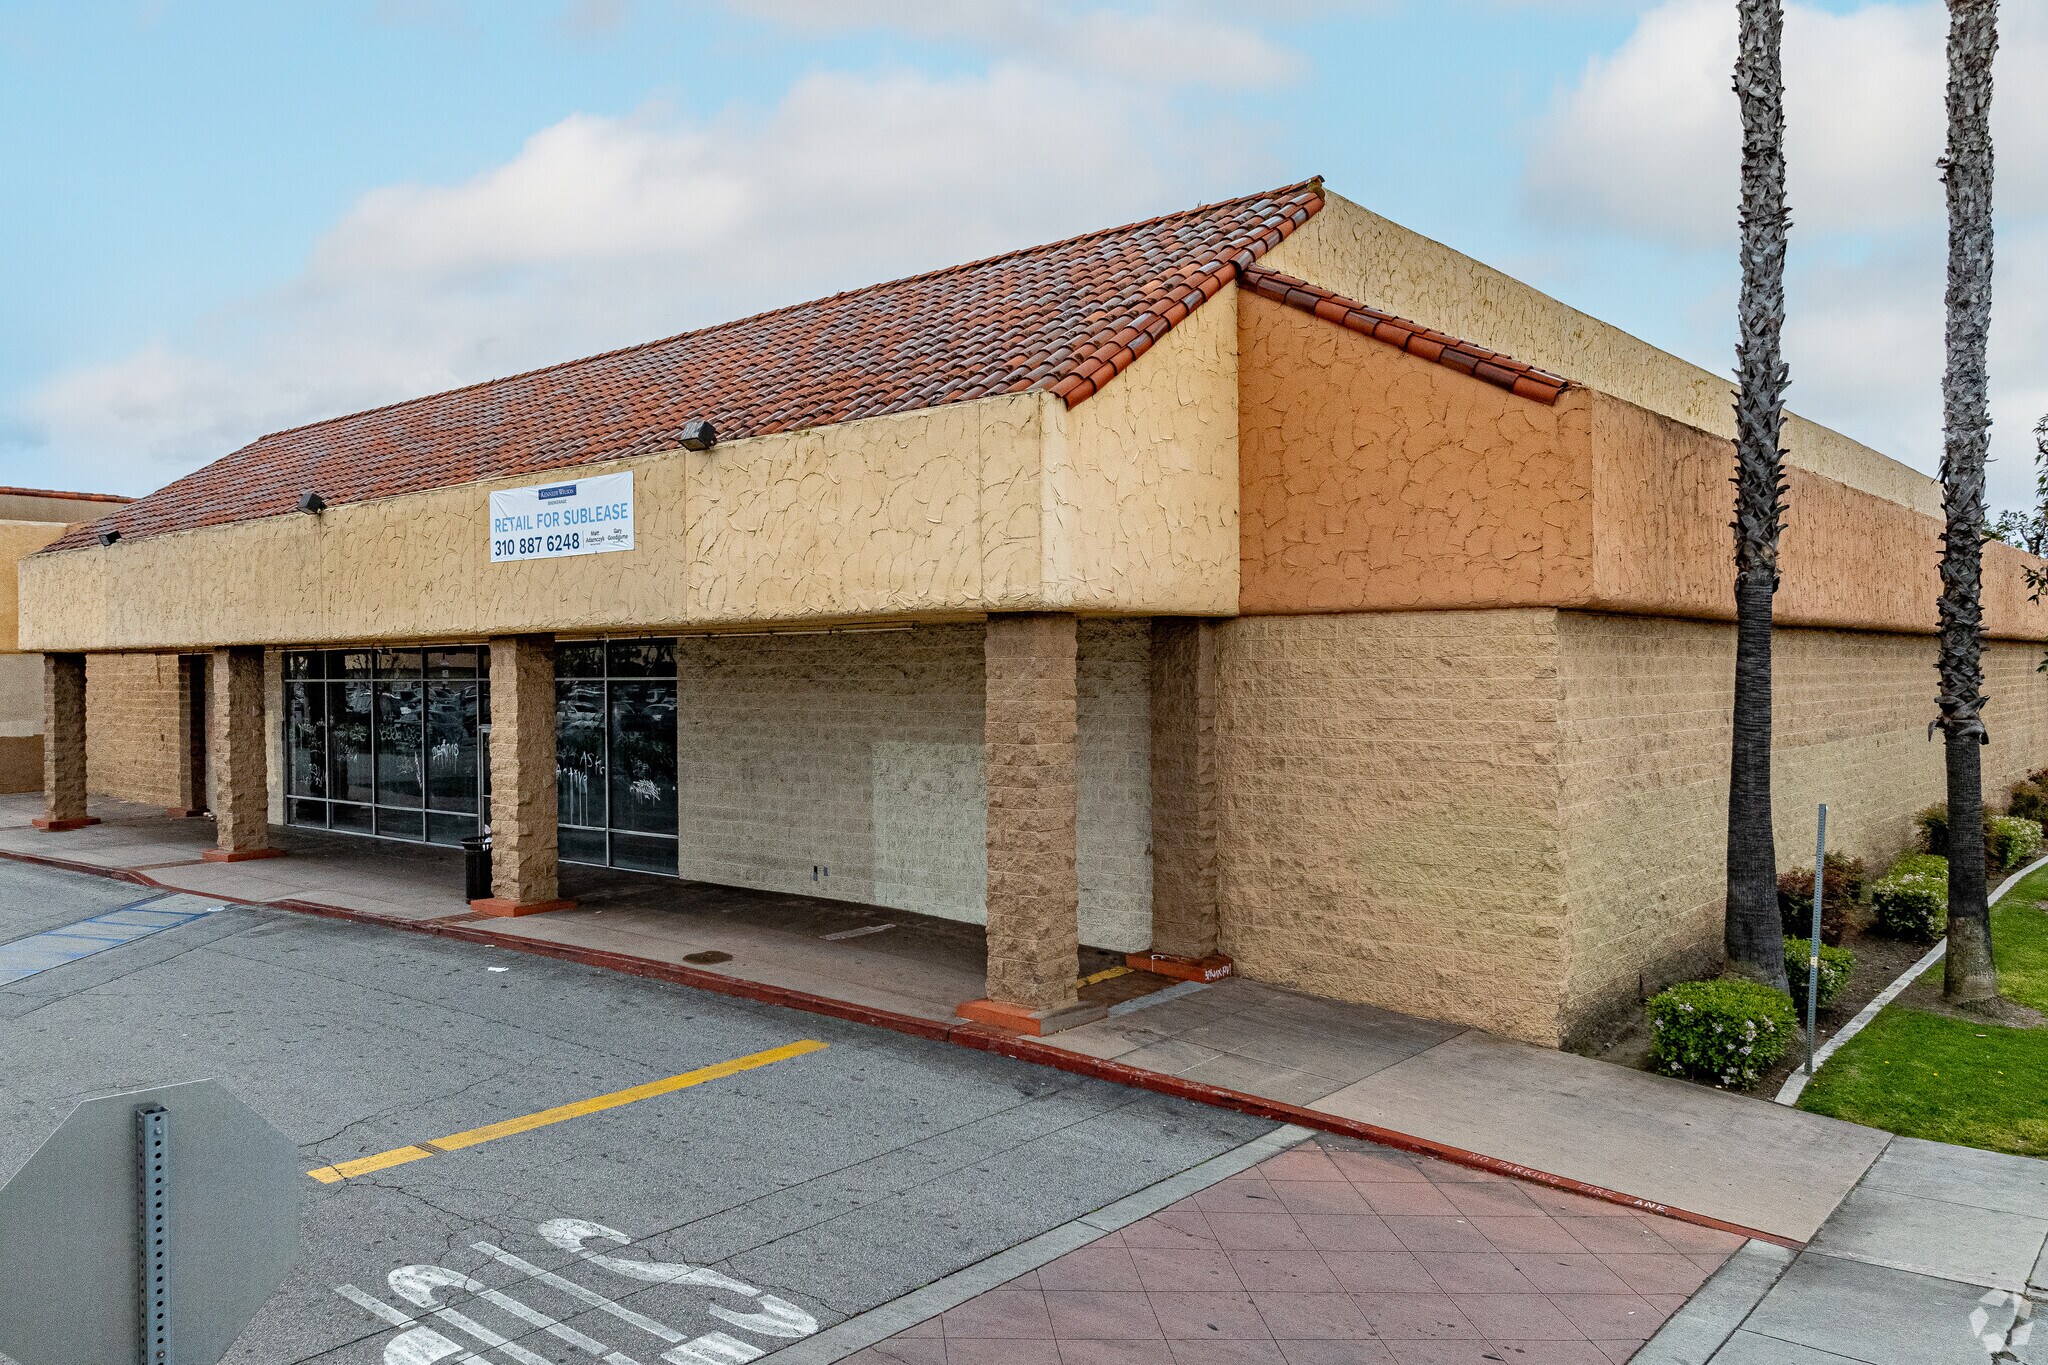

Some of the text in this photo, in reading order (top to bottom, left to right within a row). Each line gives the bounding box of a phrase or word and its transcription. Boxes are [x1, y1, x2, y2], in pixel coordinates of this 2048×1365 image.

[495, 503, 628, 533] RETAIL FOR SUBLEASE
[495, 532, 580, 556] 310 887 6248
[1468, 1153, 1668, 1213] NO PARKING FIRE LANE
